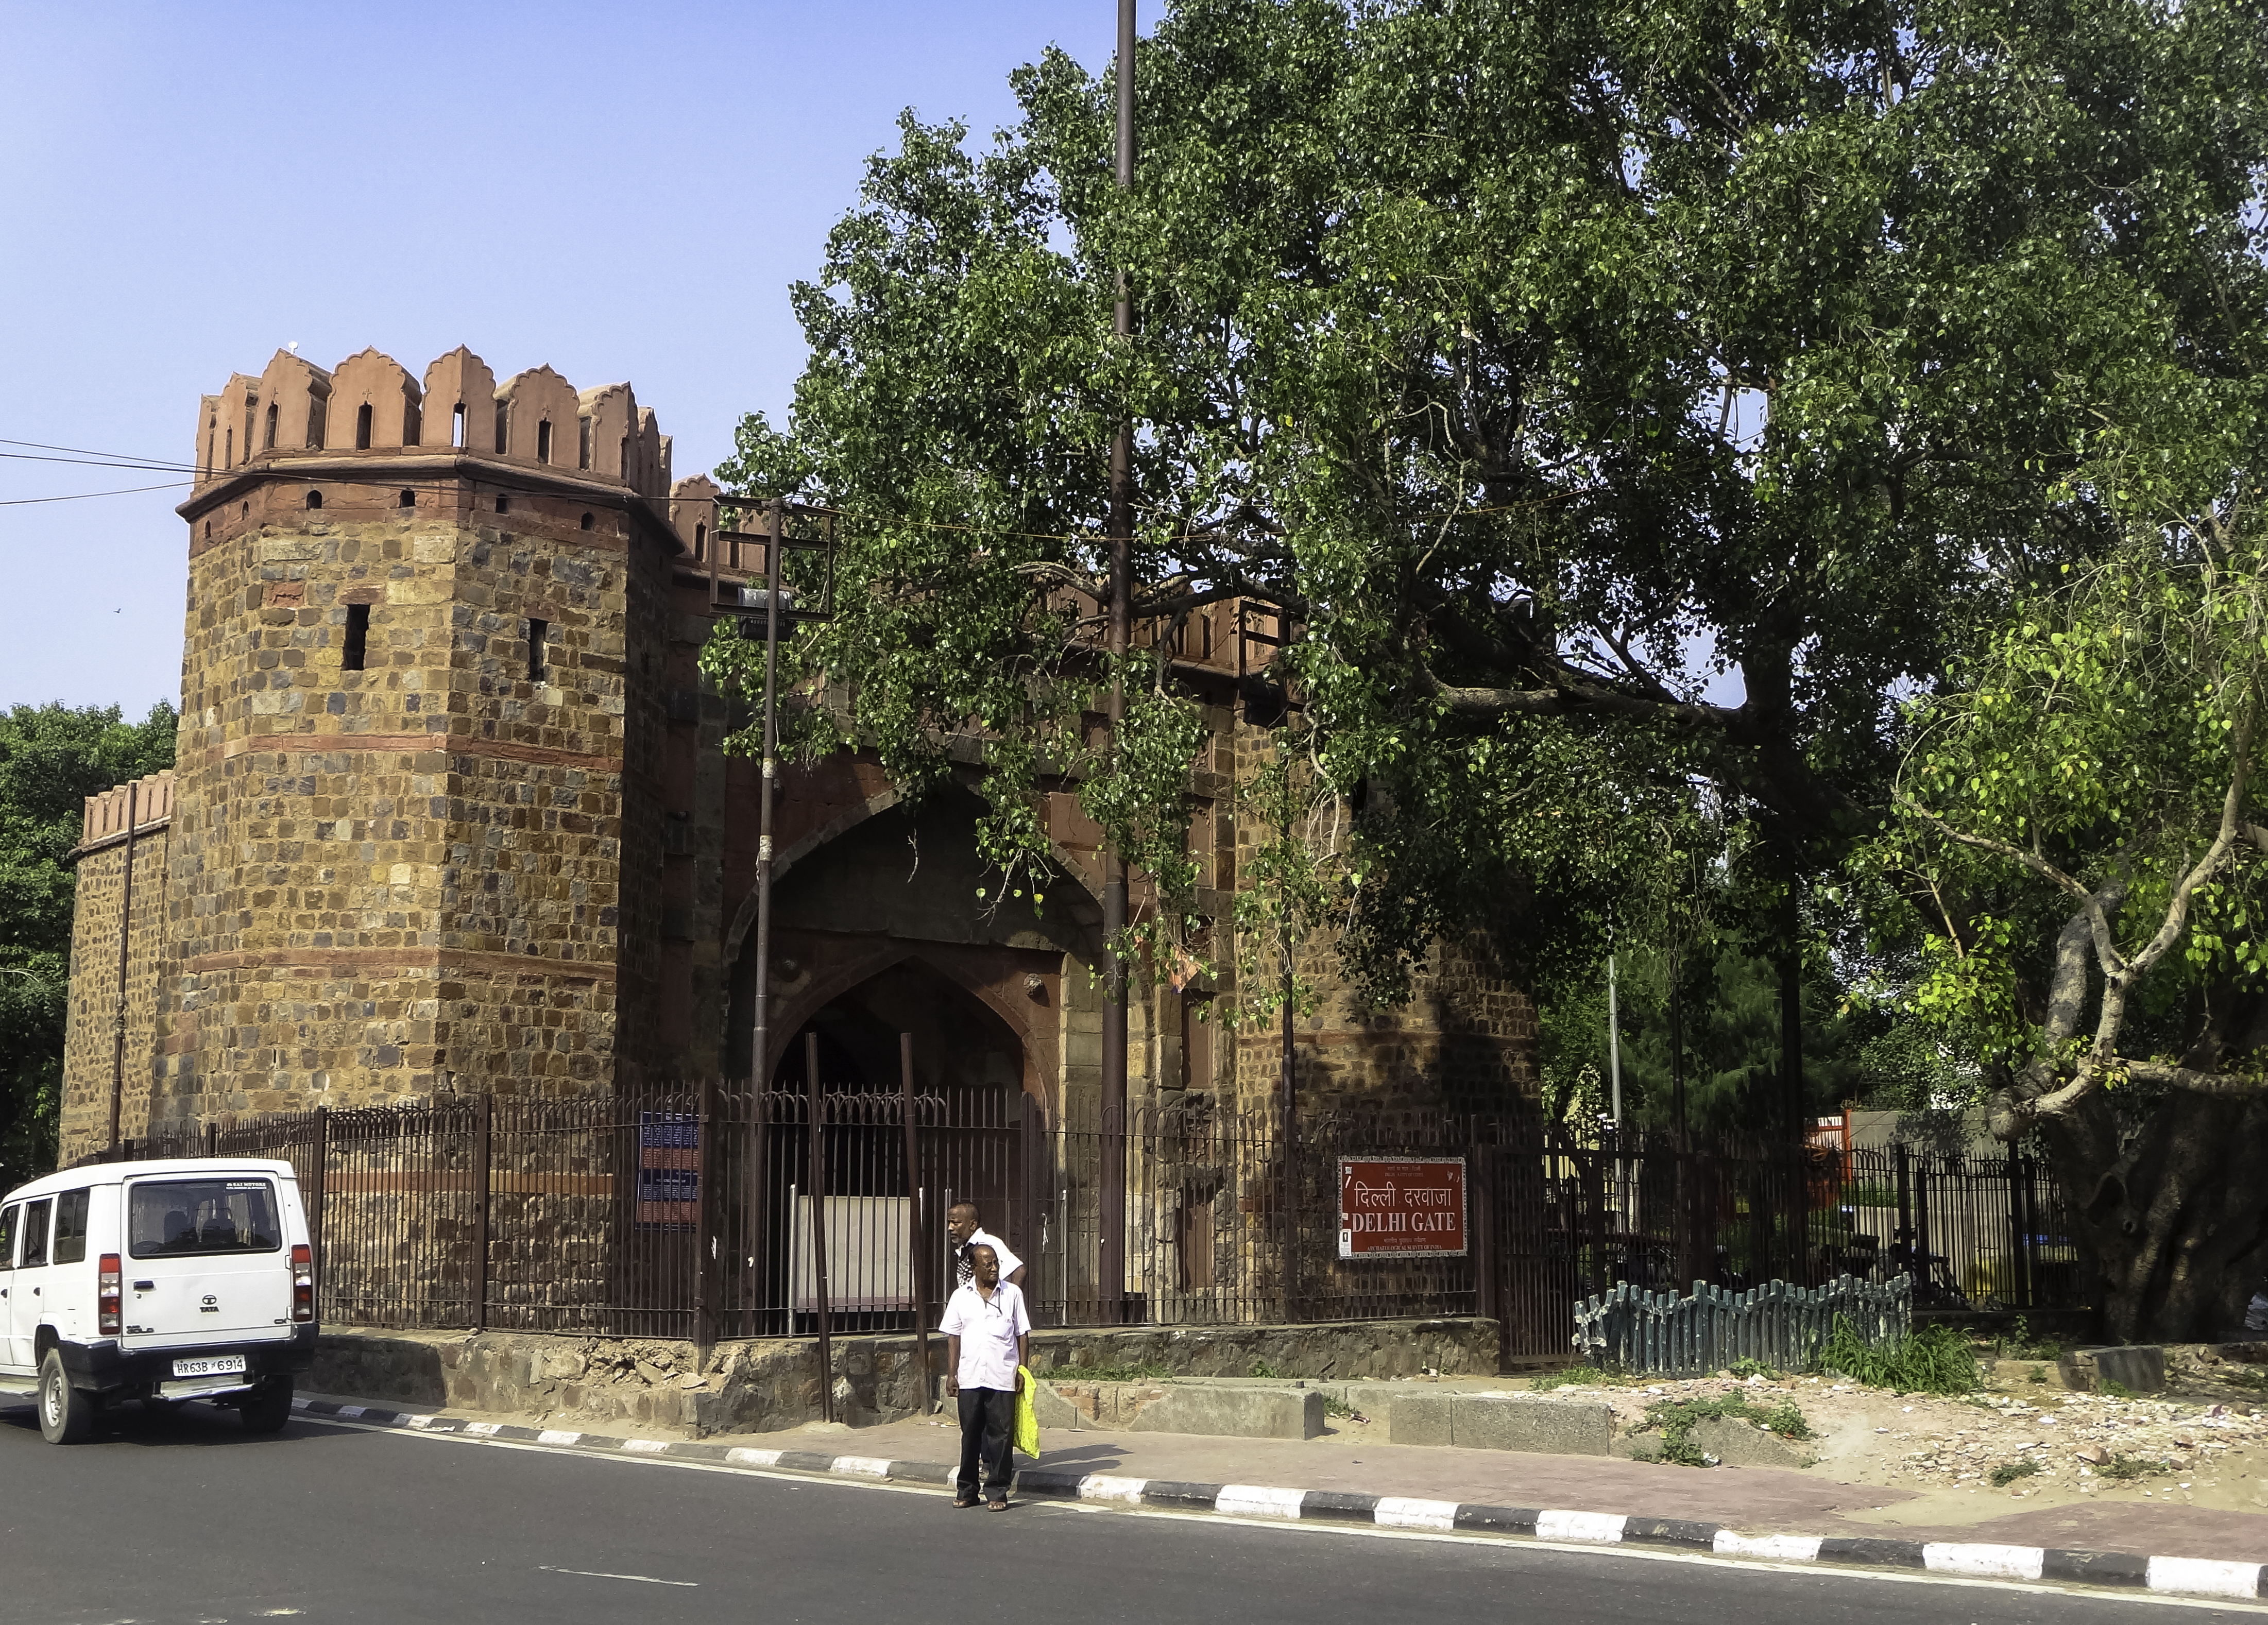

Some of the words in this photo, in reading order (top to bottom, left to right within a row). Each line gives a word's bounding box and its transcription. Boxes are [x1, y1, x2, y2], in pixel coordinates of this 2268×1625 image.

[1354, 1181, 1396, 1207] दिल्ली
[1403, 1188, 1452, 1207] दरवाजा
[1352, 1212, 1407, 1232] DELHI
[1411, 1212, 1456, 1231] GATE
[177, 1362, 208, 1374] HR63B
[217, 1359, 243, 1371] 6914
